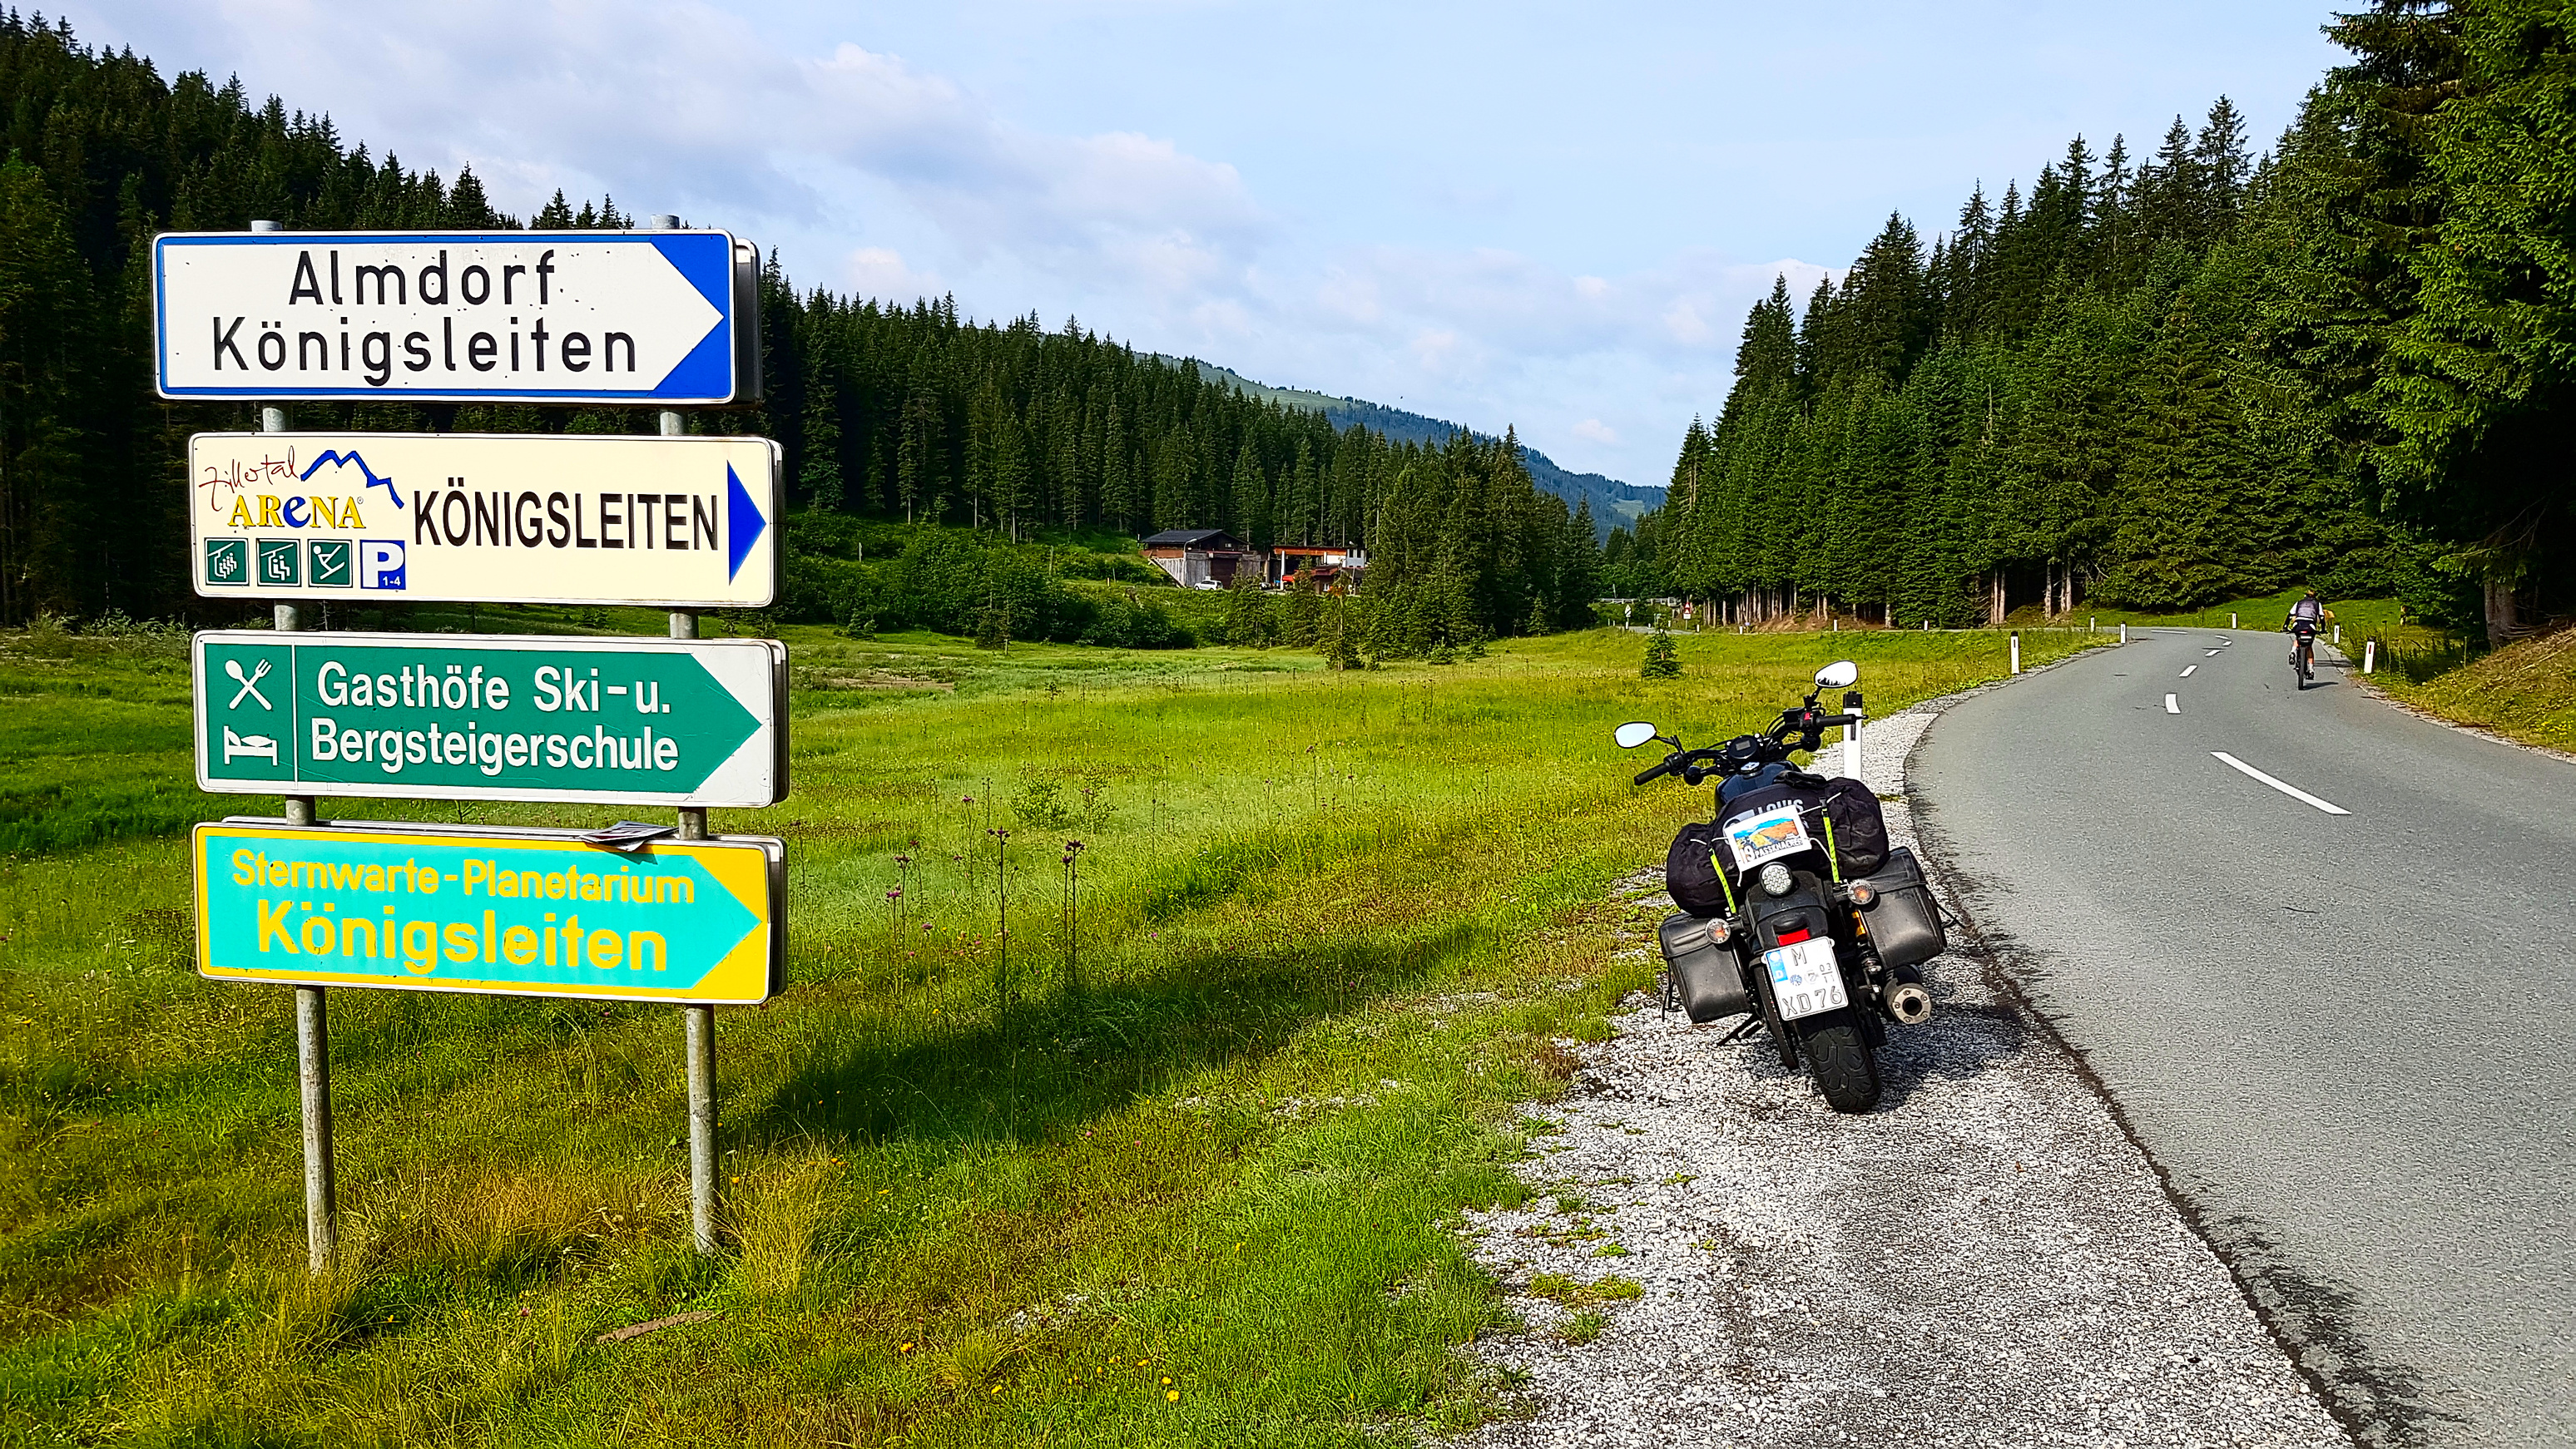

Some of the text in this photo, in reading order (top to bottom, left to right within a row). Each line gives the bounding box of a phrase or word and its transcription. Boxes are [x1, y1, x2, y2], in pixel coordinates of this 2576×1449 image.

[289, 250, 556, 305] Almdorf
[213, 315, 637, 387] Königsleiten
[199, 446, 299, 512] Zillertal
[414, 477, 719, 551] KÖNIGSLEITEN
[382, 576, 401, 586] 1-4
[317, 660, 510, 712] Gasthöfe
[311, 717, 679, 776] Bergsteigerschule
[257, 899, 668, 975] Königsleiten
[1791, 946, 1807, 966] M
[1775, 970, 1784, 979] D
